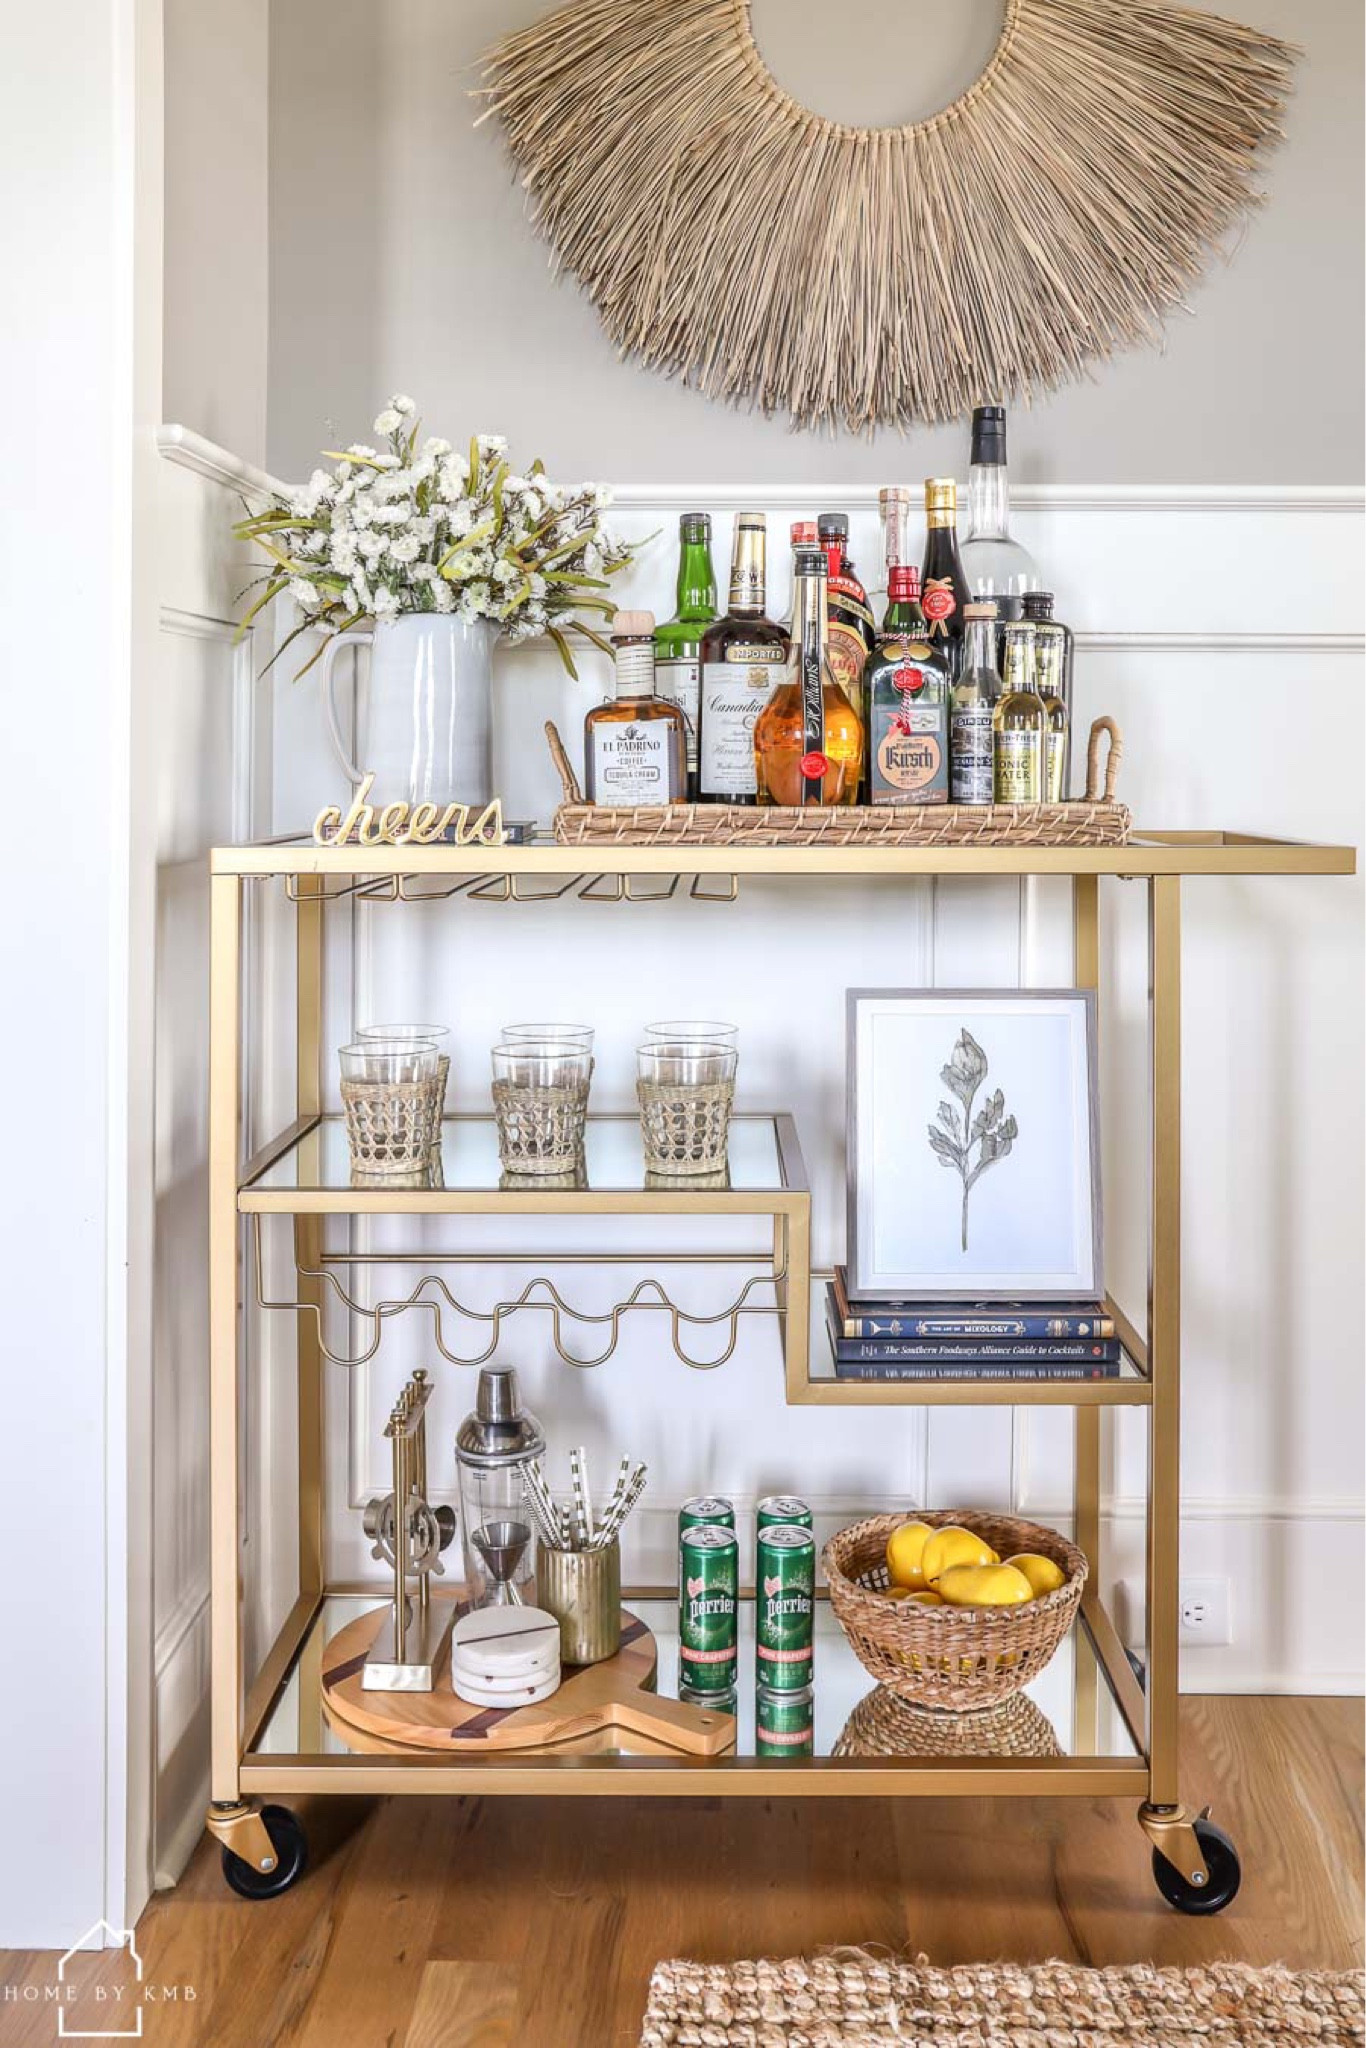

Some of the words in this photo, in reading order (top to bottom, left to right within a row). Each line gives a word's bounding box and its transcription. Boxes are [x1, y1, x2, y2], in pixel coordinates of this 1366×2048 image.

[706, 694, 764, 713] Canadia
[603, 741, 613, 752] EL
[617, 741, 661, 752] PADRINO
[886, 746, 934, 770] Kirsch
[313, 770, 509, 847] cheers
[964, 1325, 1008, 1333] MIXOLOGY
[884, 1345, 900, 1354] The
[901, 1345, 938, 1354] Southern
[979, 1345, 1011, 1354] Alliance
[1012, 1346, 1037, 1354] Guide
[1038, 1346, 1048, 1354] to
[1048, 1345, 1086, 1354] Cocktails
